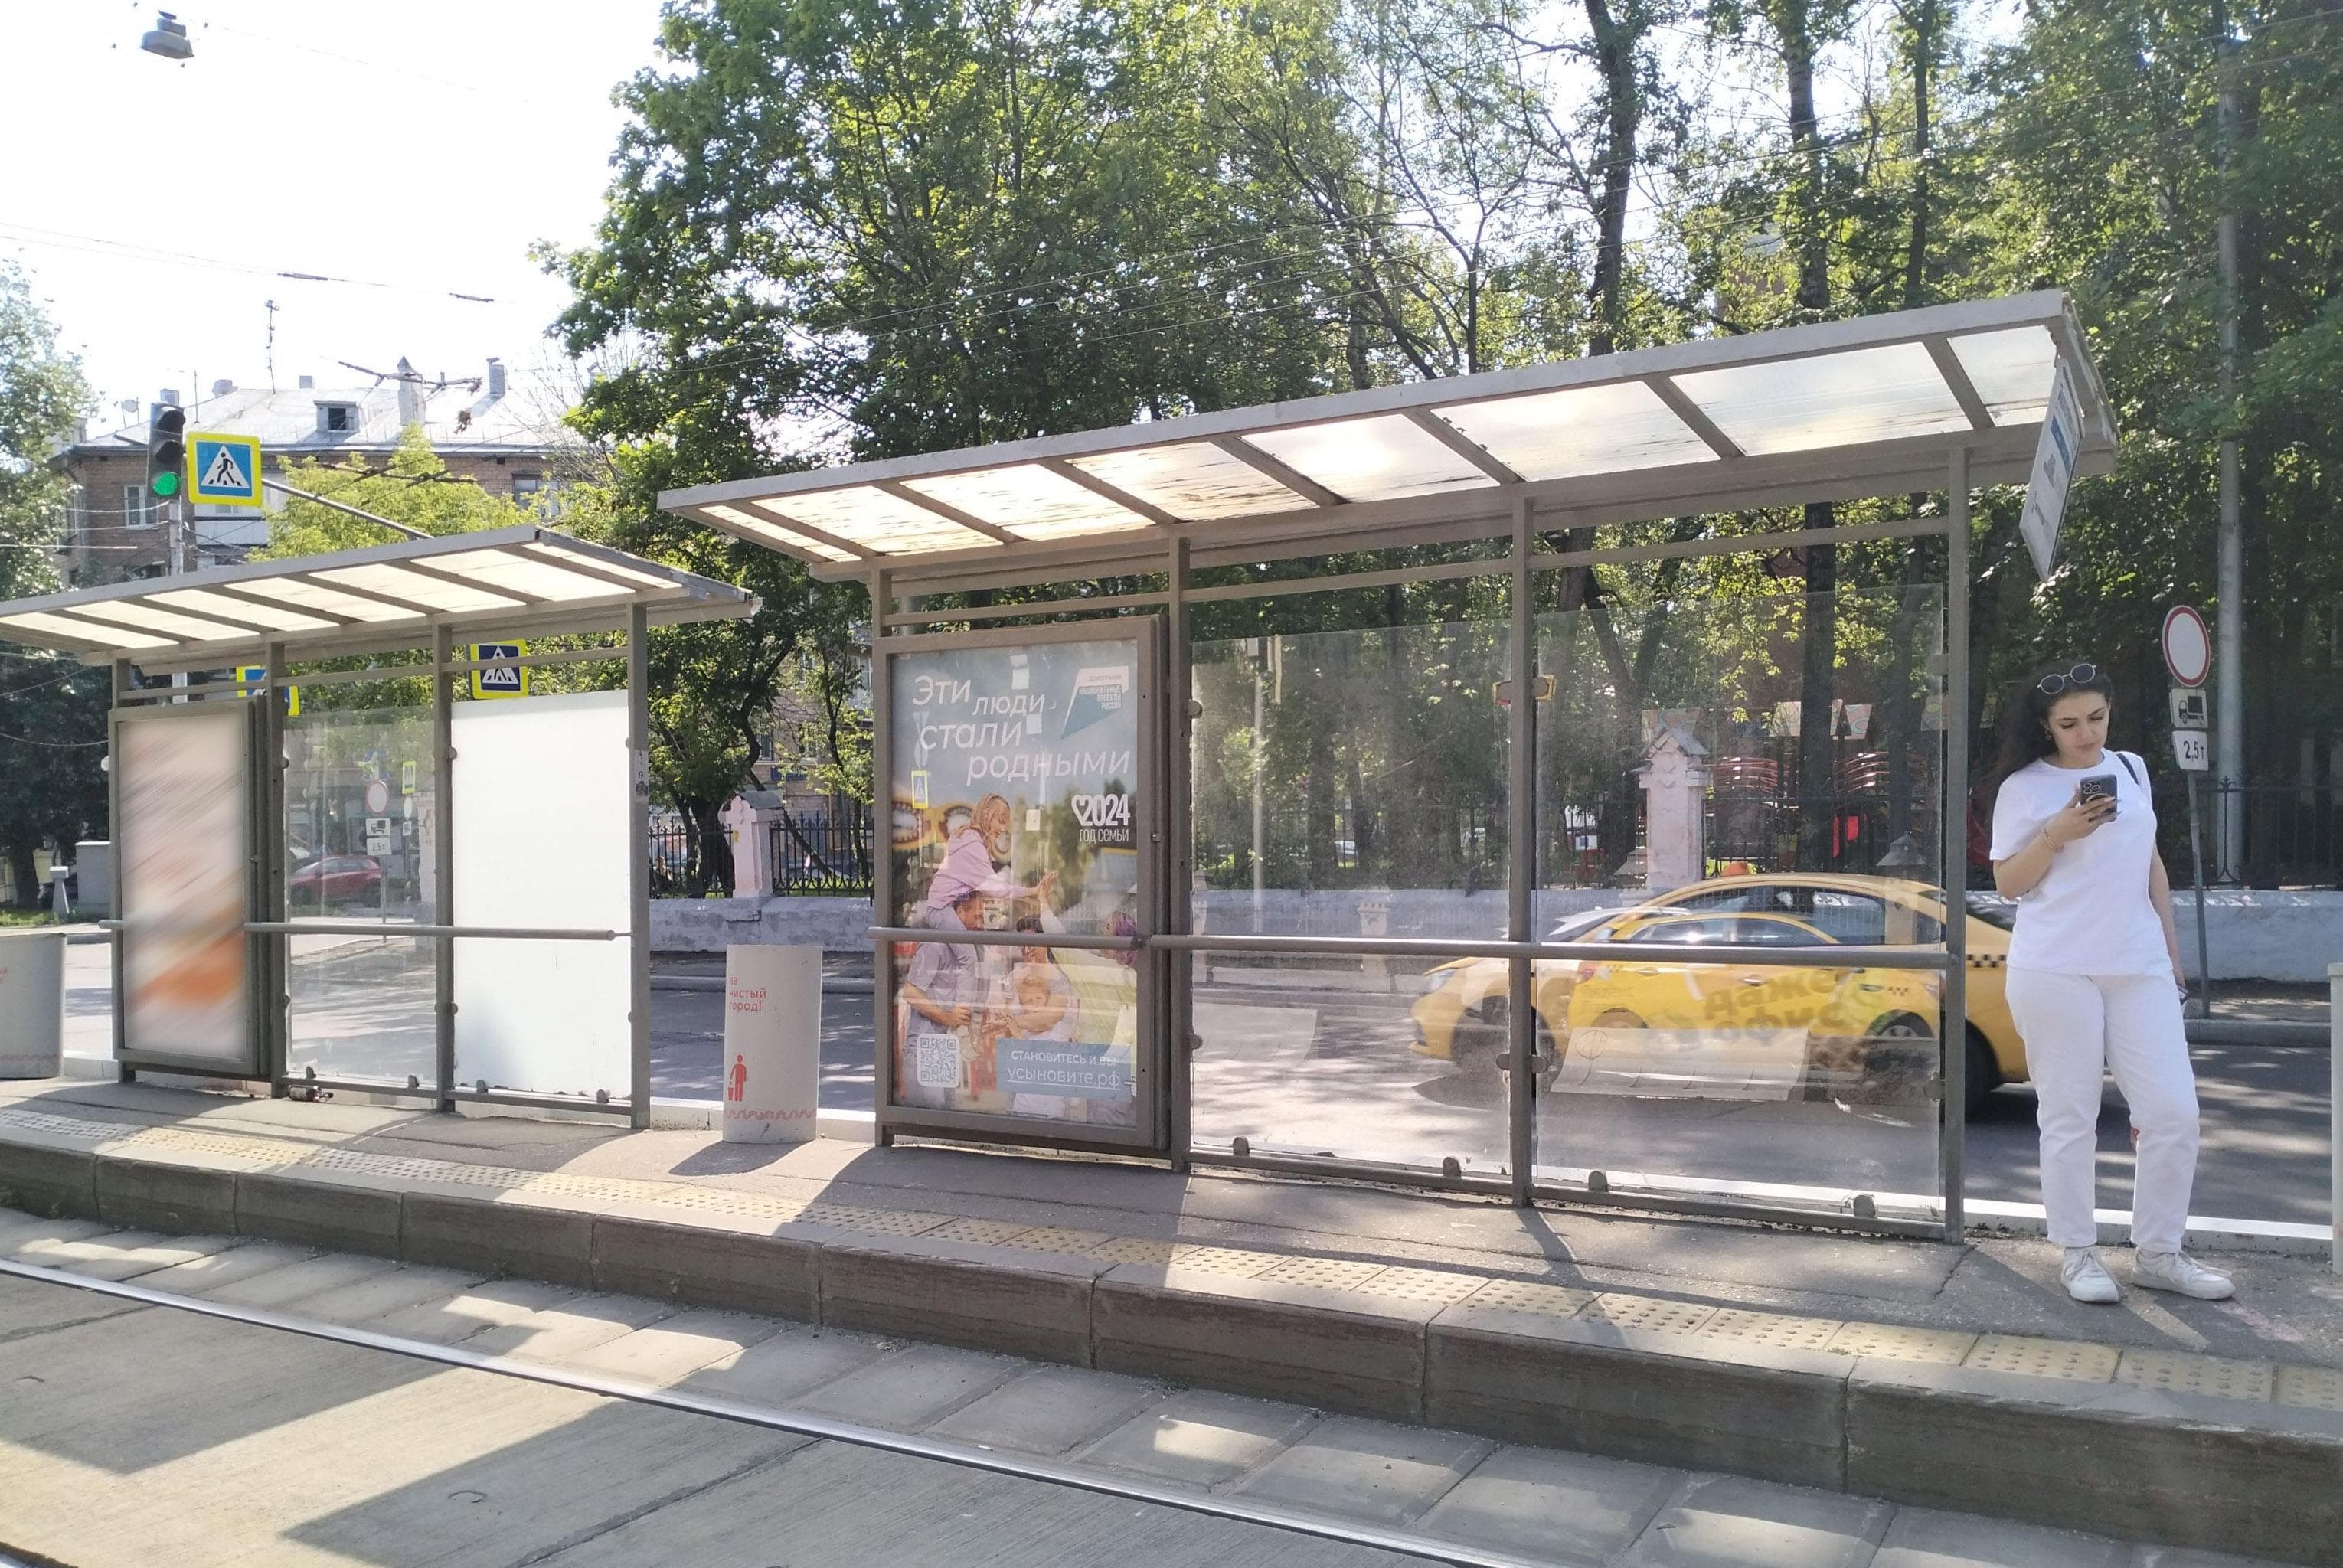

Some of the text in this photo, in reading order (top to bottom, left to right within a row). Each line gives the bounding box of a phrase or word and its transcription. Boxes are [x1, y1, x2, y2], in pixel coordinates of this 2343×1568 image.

[912, 675, 972, 706] Эти
[972, 694, 1045, 717] люди
[920, 721, 1022, 750] стали
[966, 750, 1131, 786] родными
[1071, 794, 1131, 827] 2024
[1011, 1050, 1087, 1065] СТАНОВИТЕСЬ
[1089, 1056, 1097, 1065] И
